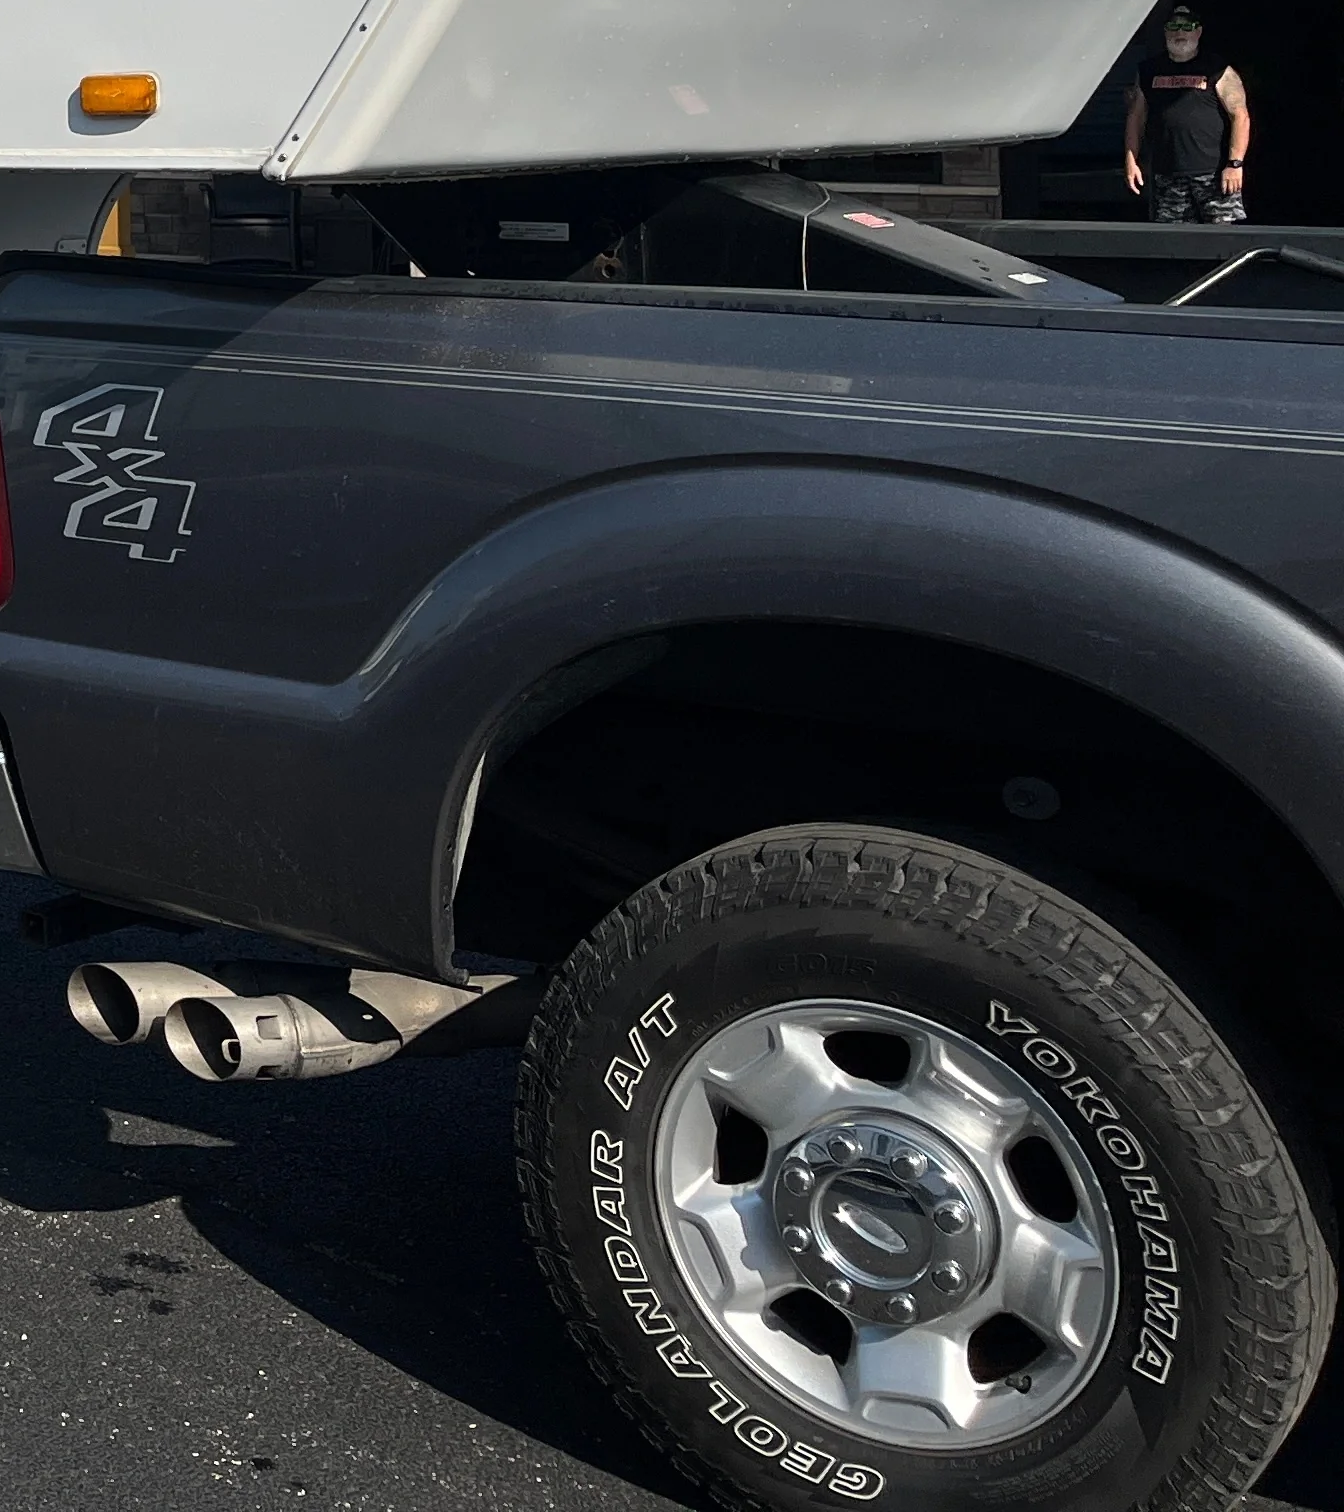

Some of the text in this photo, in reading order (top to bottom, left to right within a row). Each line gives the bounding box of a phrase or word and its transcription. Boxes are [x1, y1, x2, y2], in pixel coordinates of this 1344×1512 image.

[603, 992, 678, 1112] A/T
[986, 999, 1180, 1385] YOKOHAMA
[590, 1129, 886, 1500] GEOLANDAR
